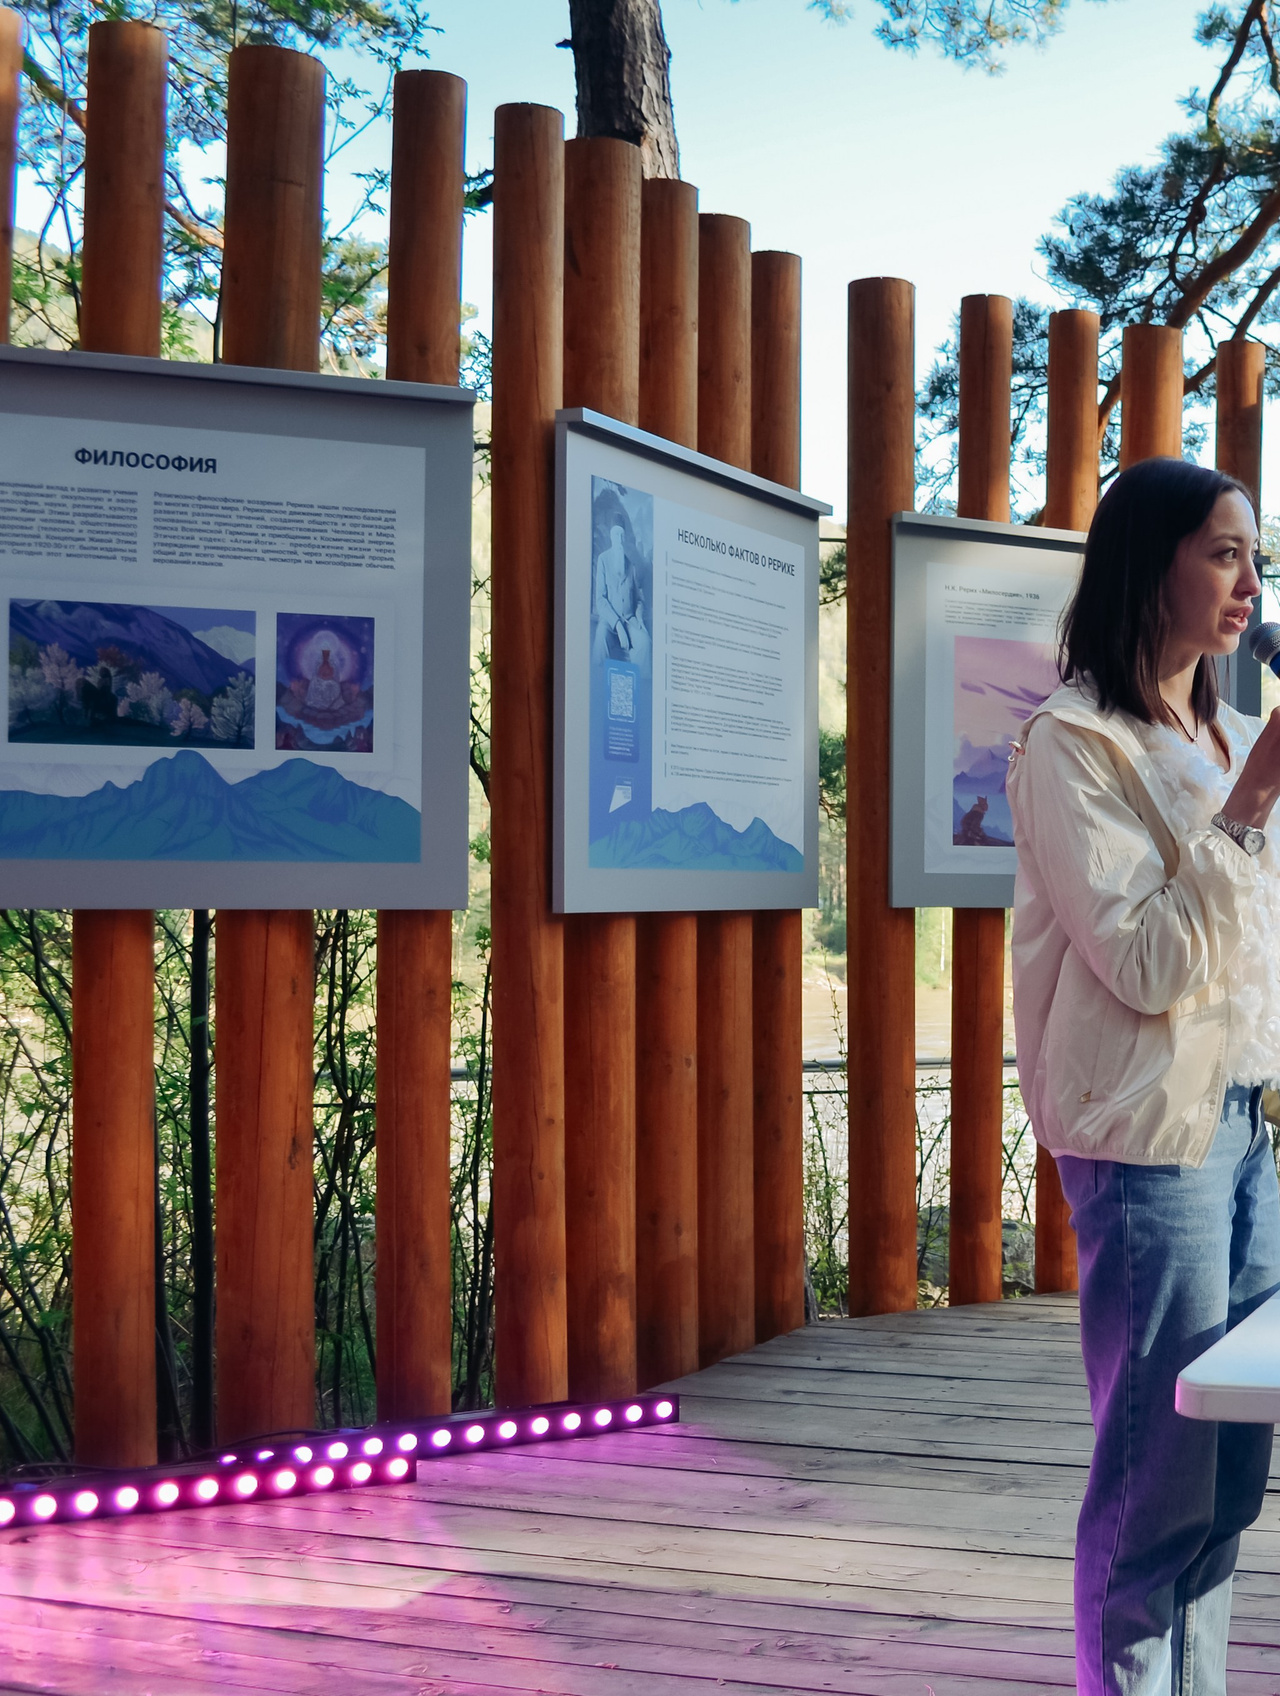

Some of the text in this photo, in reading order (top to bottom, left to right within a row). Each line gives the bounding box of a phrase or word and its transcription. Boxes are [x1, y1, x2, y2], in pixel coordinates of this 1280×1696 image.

[74, 447, 217, 474] ФИЛОСОФИЯ
[677, 528, 726, 555] НЕСКОЛЬКО
[728, 545, 759, 565] ФАКТОВ
[761, 555, 766, 567] О
[768, 556, 795, 577] РЕРИХЕ
[959, 586, 977, 595] Рерих
[1025, 592, 1040, 600] 1936
